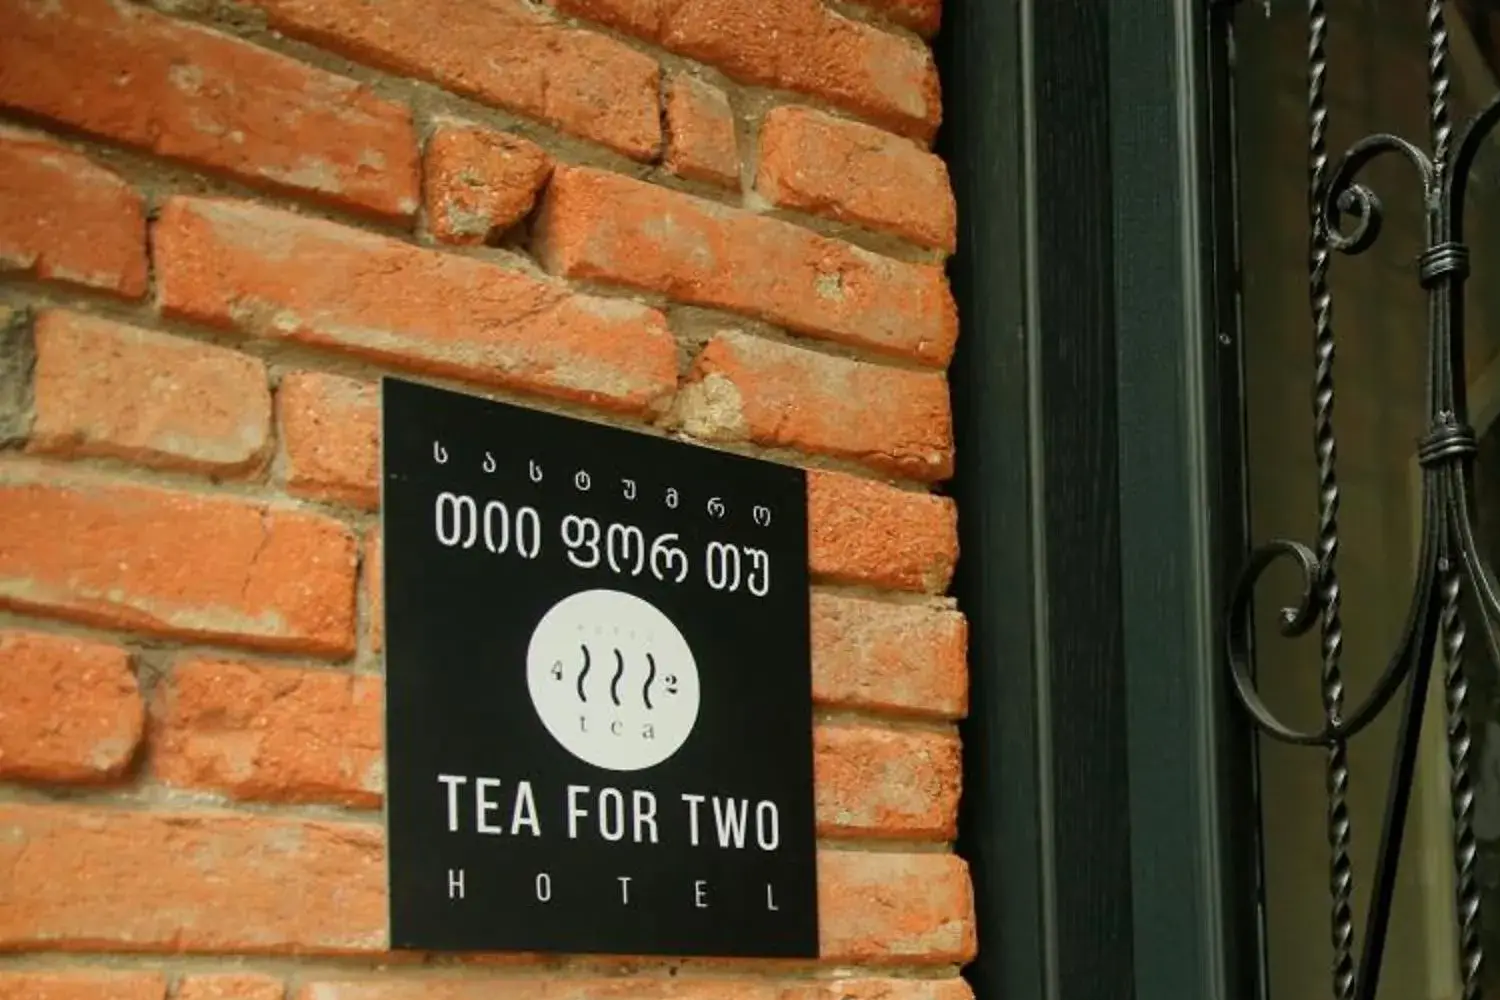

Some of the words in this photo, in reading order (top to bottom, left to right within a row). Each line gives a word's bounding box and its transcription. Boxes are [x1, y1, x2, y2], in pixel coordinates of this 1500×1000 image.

[435, 491, 541, 559] თიი
[560, 514, 689, 583] ფორ
[705, 541, 769, 597] თუ
[550, 659, 564, 682] 4
[664, 673, 679, 696] 2
[437, 773, 542, 837] TEA
[567, 784, 659, 844] FOR
[681, 793, 779, 851] TWO
[448, 868, 779, 911] HOTEL
